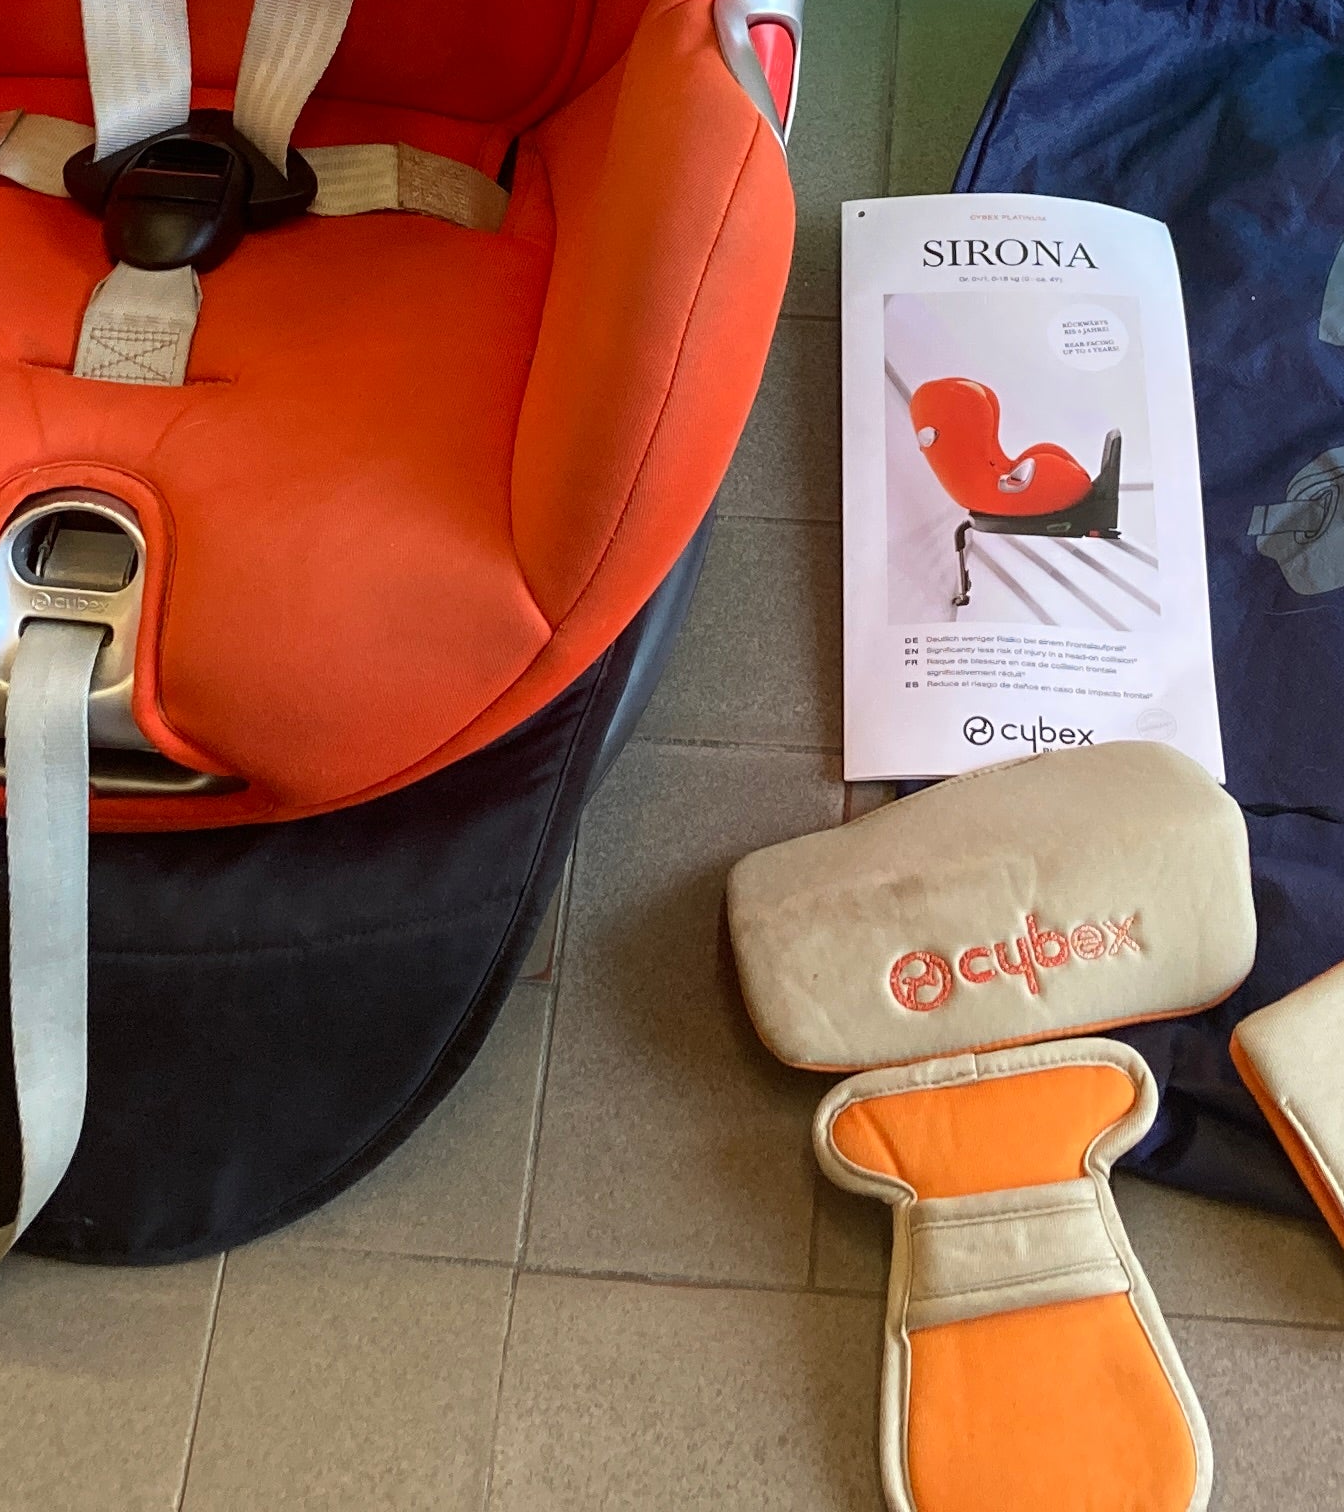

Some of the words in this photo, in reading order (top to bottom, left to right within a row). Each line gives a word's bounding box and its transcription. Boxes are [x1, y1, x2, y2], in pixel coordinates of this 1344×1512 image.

[923, 238, 1100, 269] SIRONA
[961, 636, 995, 644] weniger
[926, 647, 976, 655] Significantly
[1023, 649, 1047, 658] injury
[1065, 651, 1099, 662] head-on
[926, 658, 956, 666] Risque
[970, 658, 1007, 666] blessure
[1037, 661, 1049, 669] de
[1050, 663, 1085, 672] collision
[1086, 665, 1117, 674] frontale
[926, 669, 996, 677] significativement
[961, 680, 970, 688] el
[971, 681, 998, 689] riesgo
[999, 681, 1011, 689] de
[1012, 682, 1039, 691] daños
[1053, 686, 1074, 694] caso
[1075, 687, 1087, 695] de
[1087, 688, 1122, 699] impacto
[1000, 716, 1095, 753] cybex
[958, 913, 1142, 996] cybex
